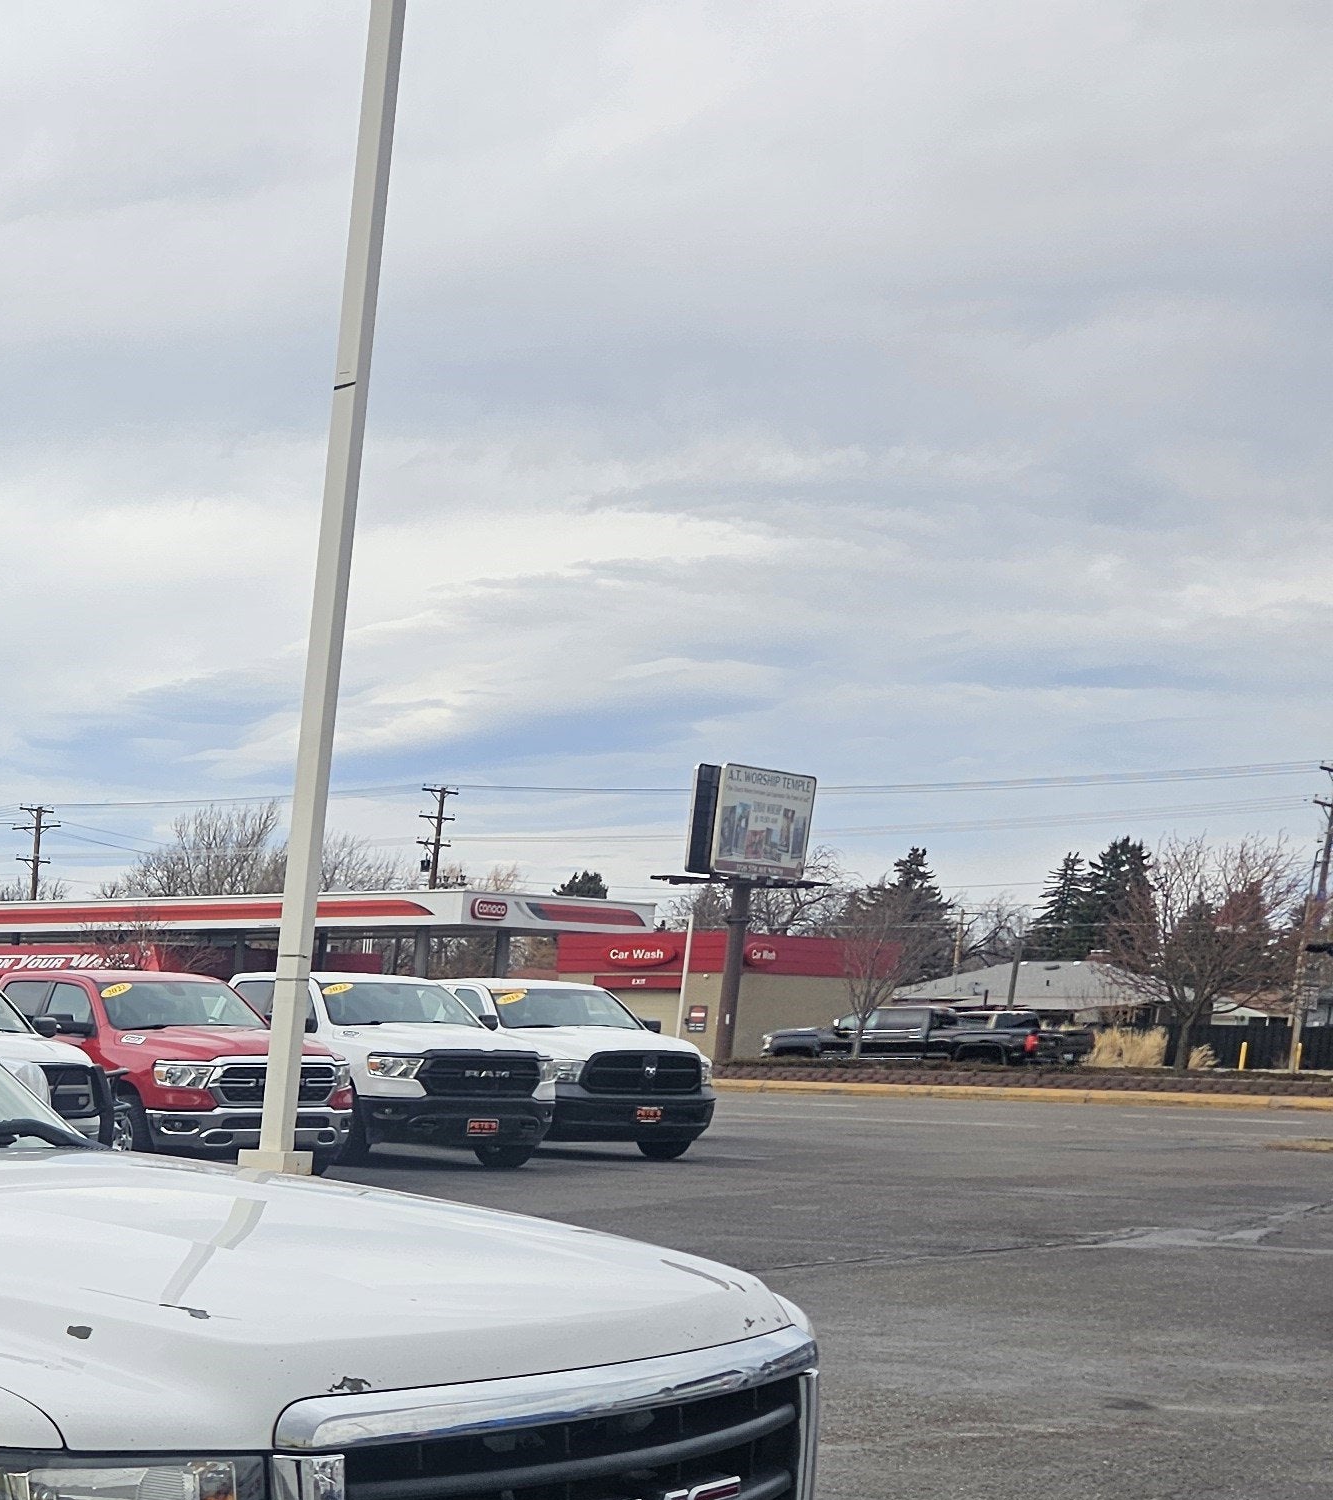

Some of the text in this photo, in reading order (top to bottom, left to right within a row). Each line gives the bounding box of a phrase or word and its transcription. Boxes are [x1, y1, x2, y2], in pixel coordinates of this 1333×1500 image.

[744, 770, 780, 788] WORSHIP
[782, 777, 812, 794] TEMPLE
[609, 949, 664, 960] Car Wash
